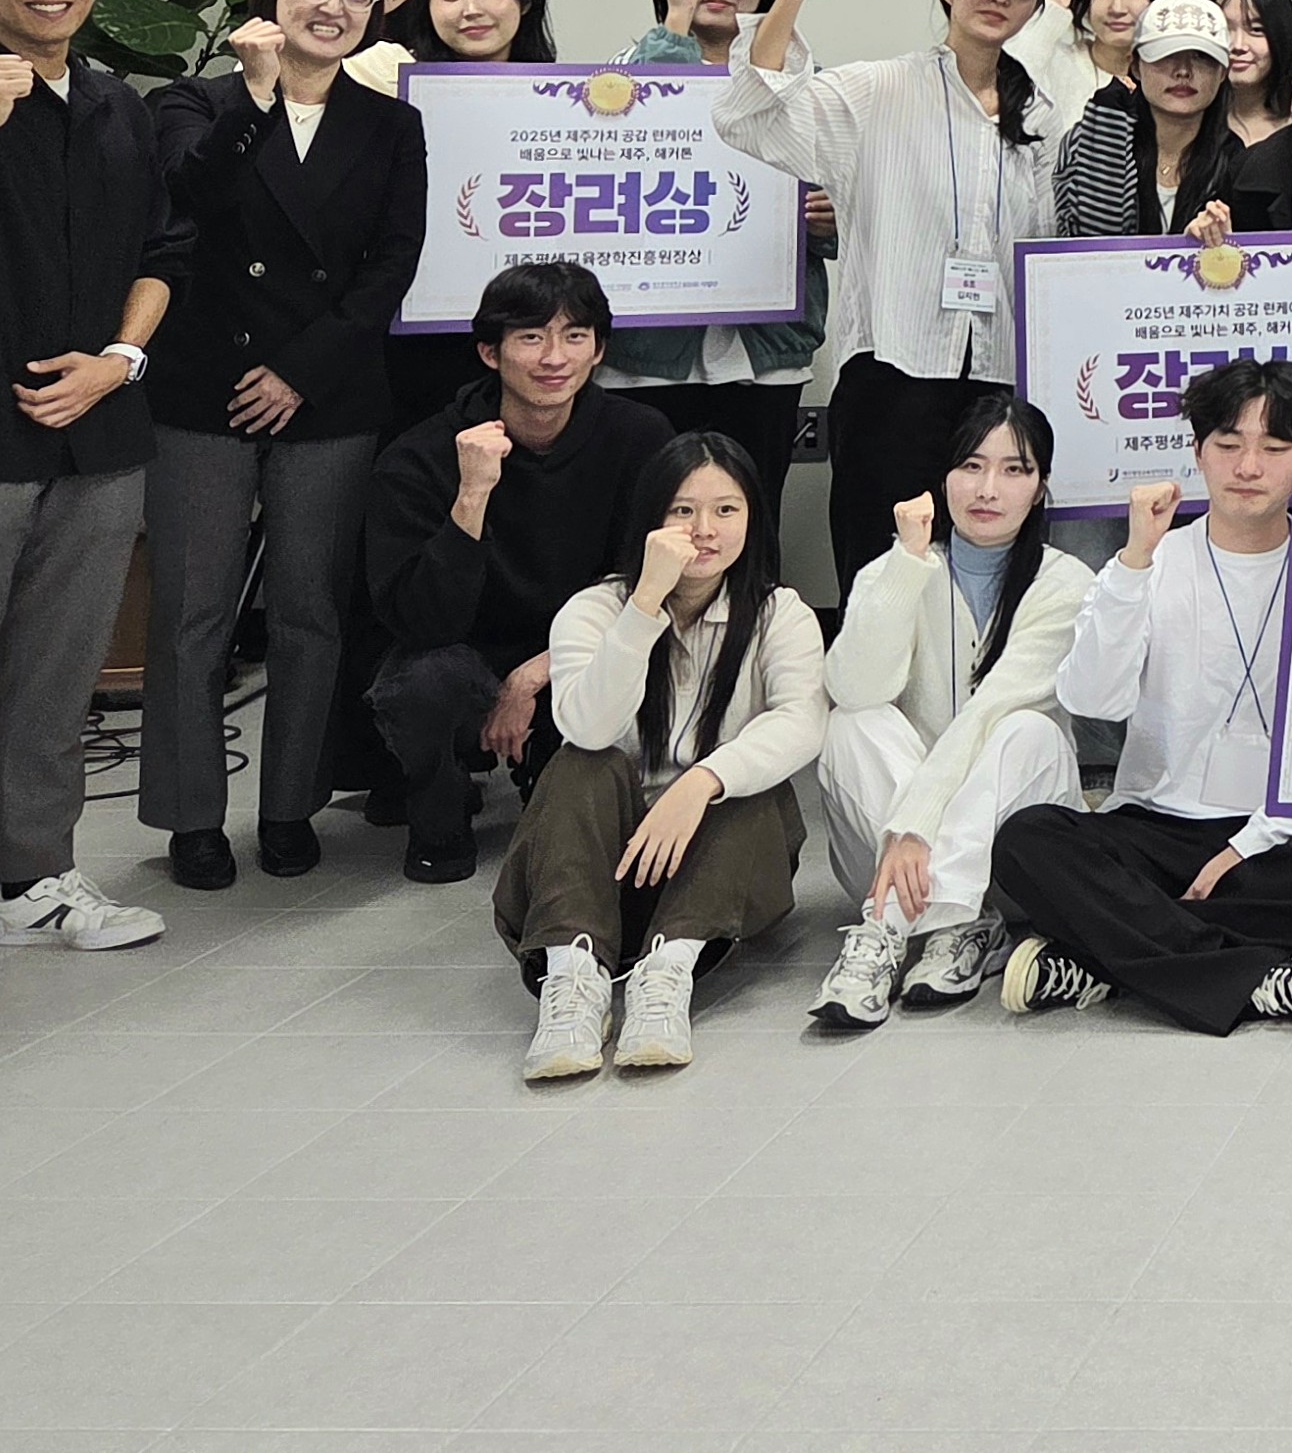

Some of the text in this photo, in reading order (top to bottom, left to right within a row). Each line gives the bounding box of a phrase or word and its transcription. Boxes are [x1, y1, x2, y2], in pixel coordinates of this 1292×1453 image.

[511, 129, 702, 142] 2025년 제주가치 공감 런케이션
[520, 147, 692, 161] 배움으로 빛나는 제주, 해커톤
[497, 171, 717, 237] 장려상
[1125, 306, 1174, 320] 2025년
[1179, 304, 1229, 318] 제주가치
[1234, 303, 1259, 317] 공감
[1135, 325, 1186, 339] 배움으로
[1191, 324, 1227, 337] 빛나는
[1232, 322, 1261, 336] 제주,
